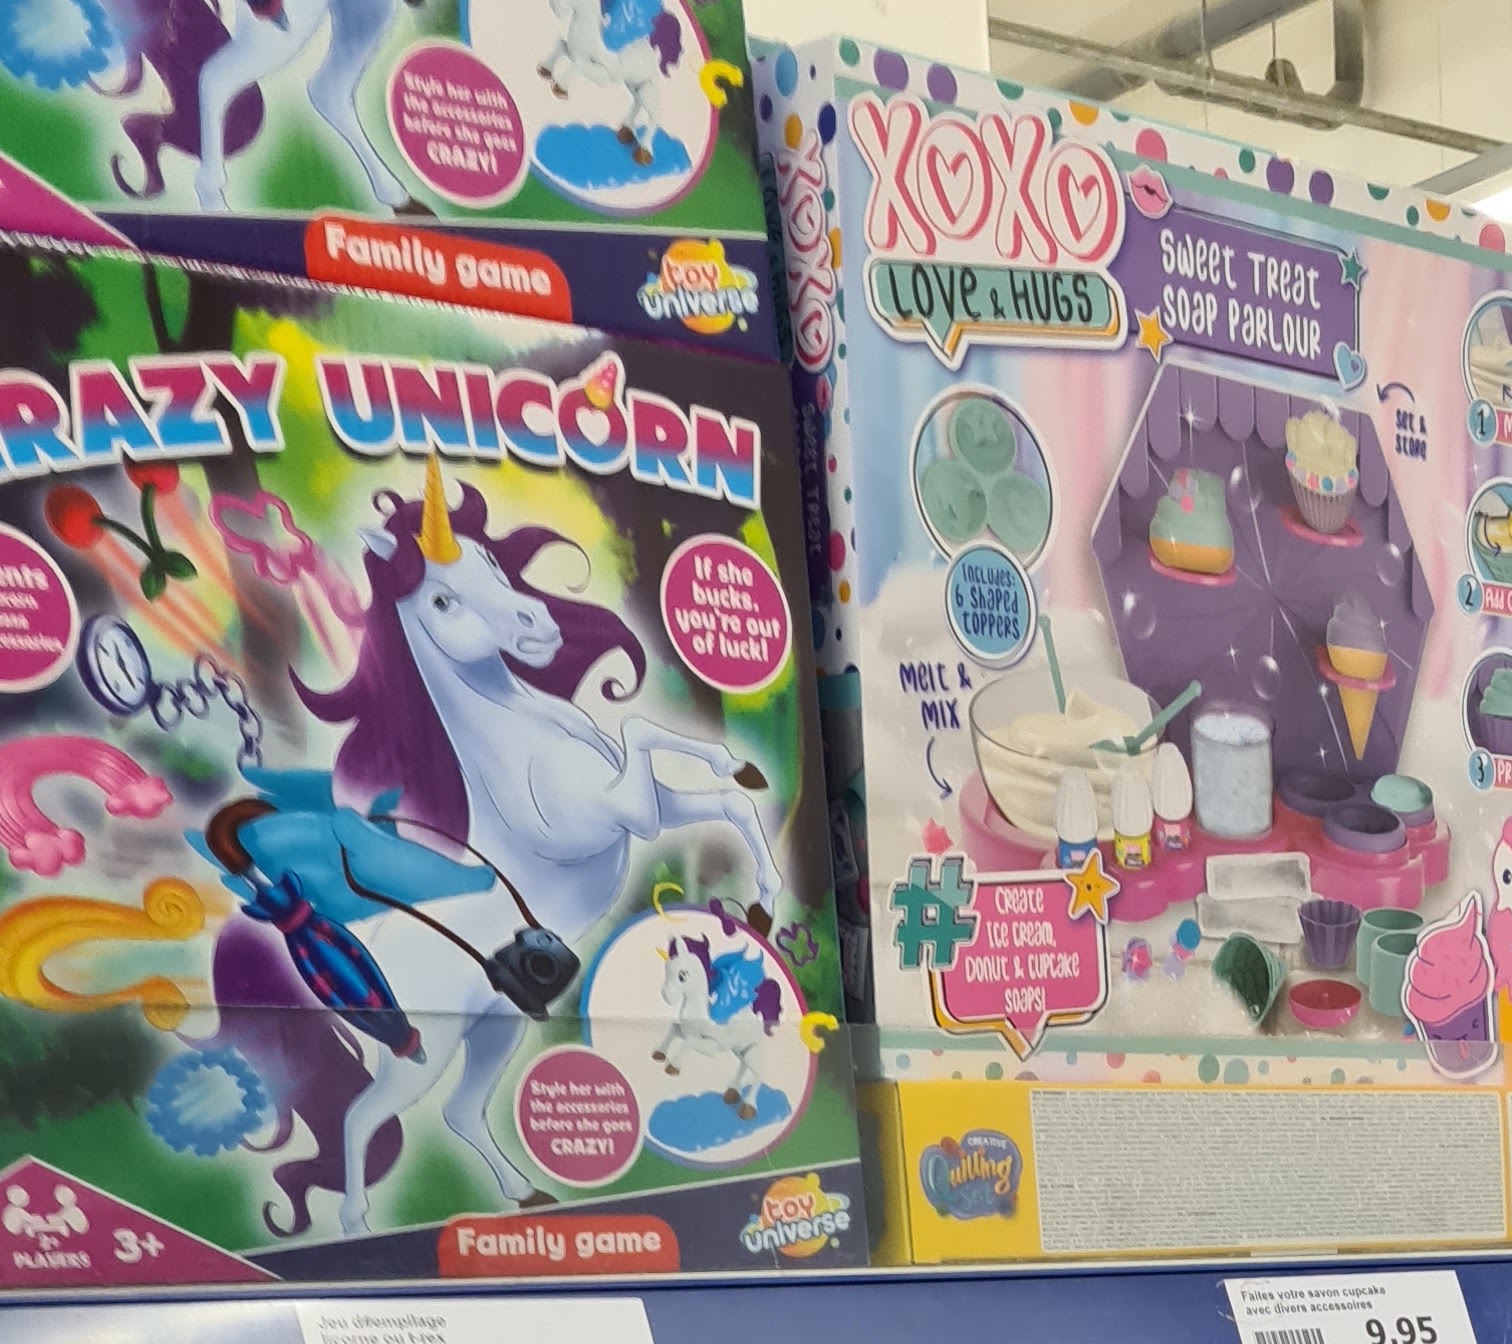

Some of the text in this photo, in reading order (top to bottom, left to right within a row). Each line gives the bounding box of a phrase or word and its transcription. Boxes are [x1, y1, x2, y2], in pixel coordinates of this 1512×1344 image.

[851, 95, 1123, 263] XOXO
[324, 223, 552, 297] Family game
[664, 259, 719, 293] toy
[888, 263, 1094, 322] LOVE & HUGS
[315, 354, 762, 509] UNICORN
[694, 556, 753, 586] If she
[675, 608, 781, 639] you're out
[692, 634, 769, 662] of luck!
[921, 696, 961, 732] MIX
[568, 1081, 590, 1095] her
[594, 1082, 625, 1097] with
[530, 1099, 629, 1114] the accessories
[530, 1116, 632, 1135] before she goes
[551, 1138, 615, 1155] CRAZY!
[765, 1194, 814, 1222] toy
[115, 1228, 165, 1262] 3+
[458, 1228, 661, 1261] Family game
[744, 1212, 851, 1250] universe
[1242, 1285, 1385, 1302] Faites votre savon cupcake
[1246, 1300, 1373, 1316] avec divers accessoires
